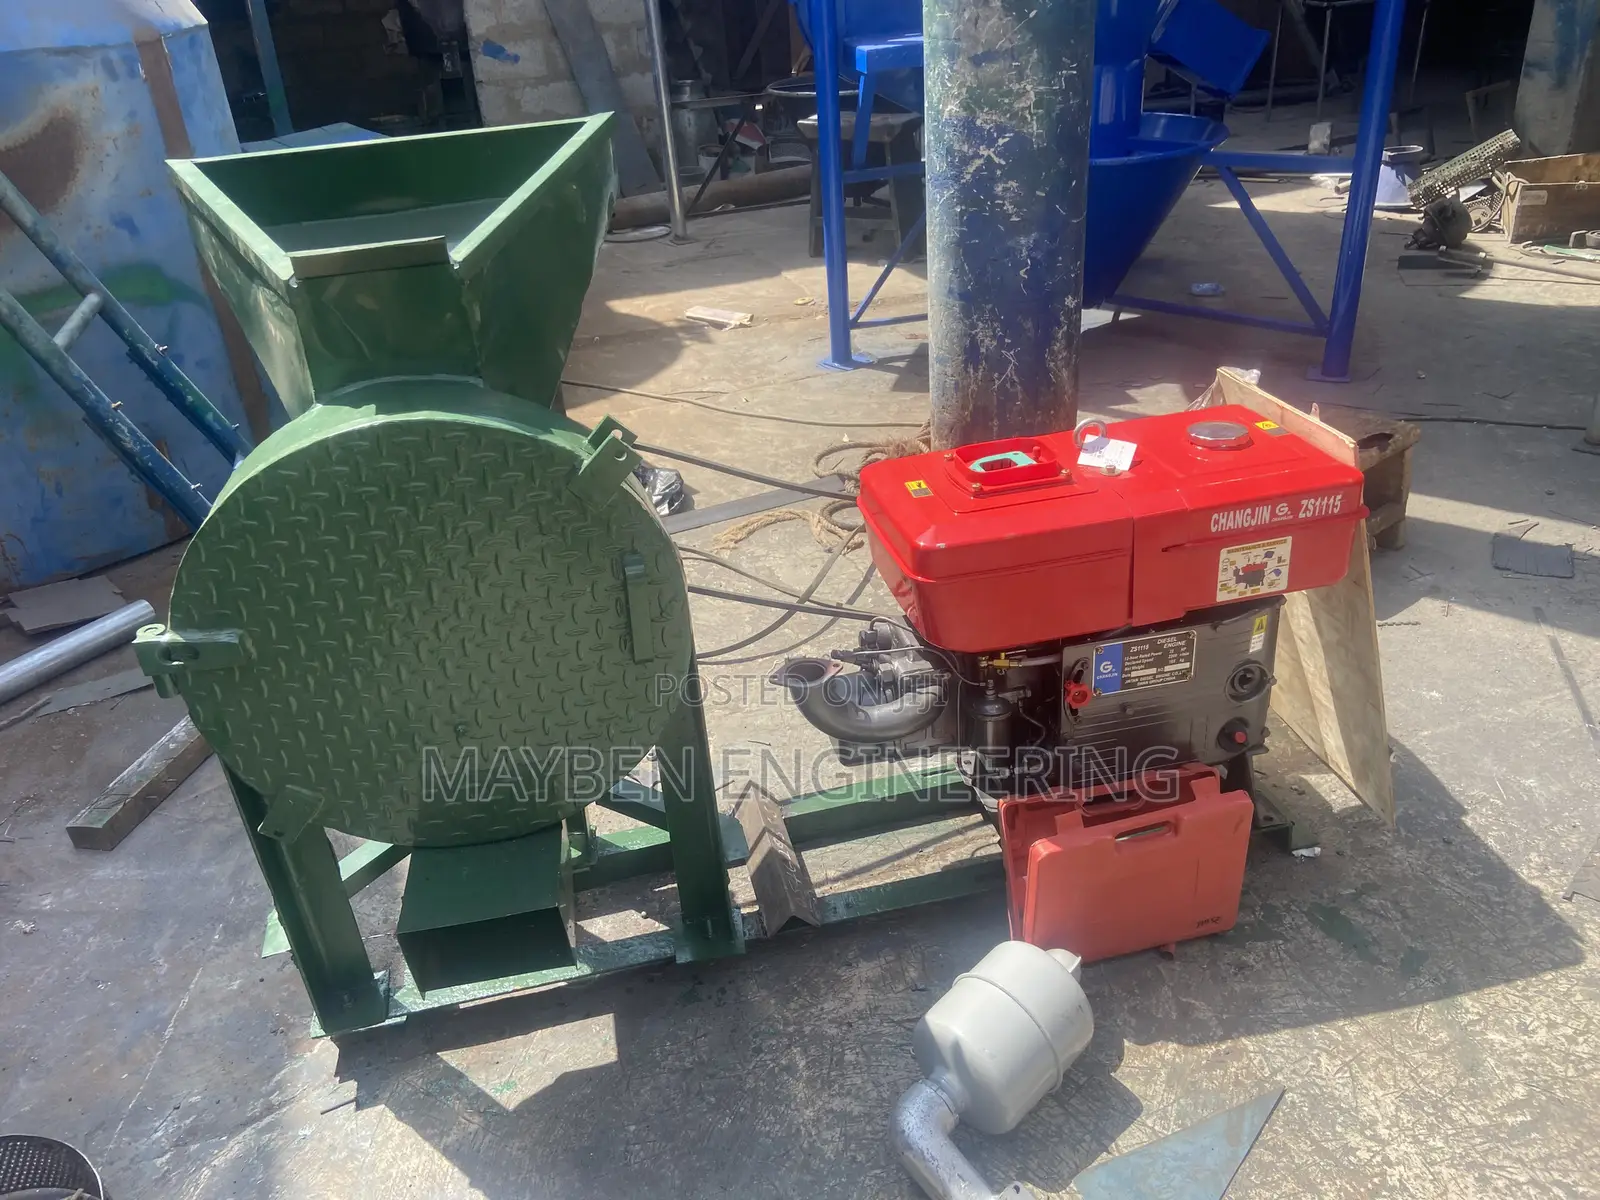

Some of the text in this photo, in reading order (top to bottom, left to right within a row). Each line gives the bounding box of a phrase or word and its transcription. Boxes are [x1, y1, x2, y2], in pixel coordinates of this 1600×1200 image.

[1211, 505, 1271, 532] CHANGJIN
[1299, 495, 1342, 518] ZS1115
[1157, 636, 1177, 645] DIESEL
[1163, 640, 1187, 649] ENGINE
[1130, 644, 1150, 653] ZS1115
[1096, 672, 1118, 680] CHANGJIN
